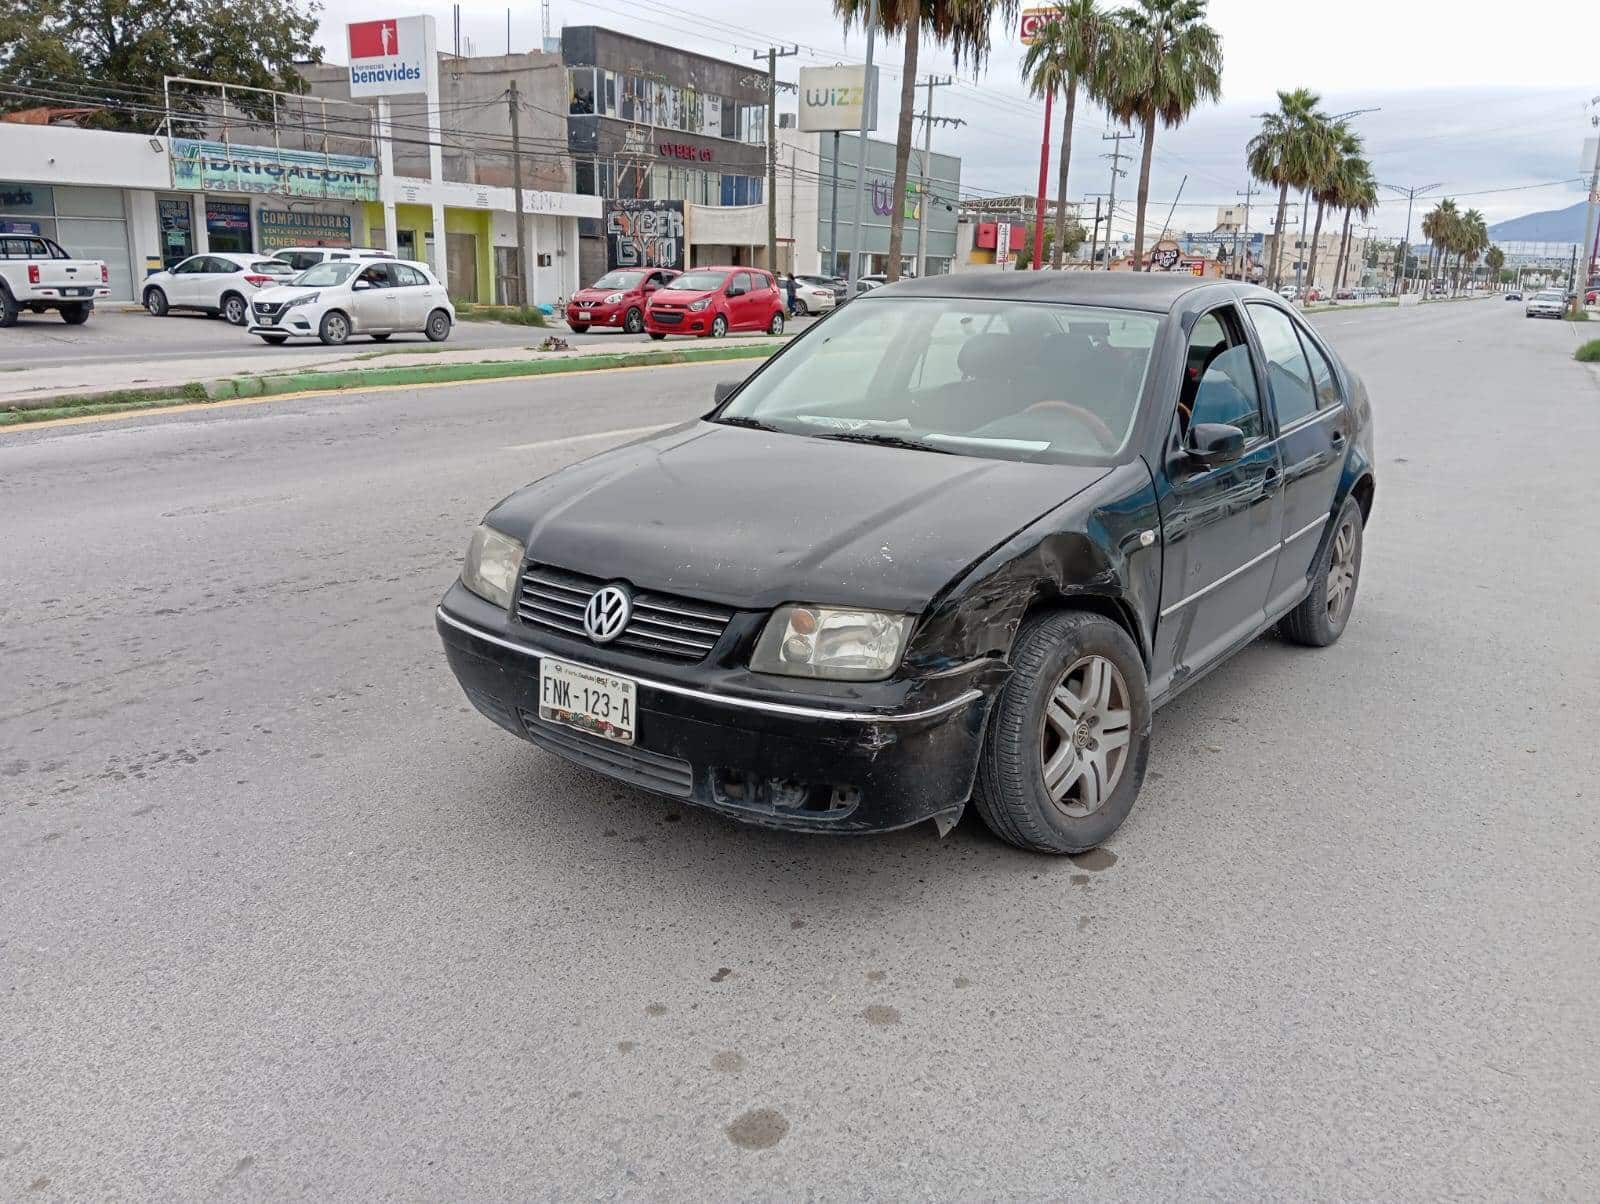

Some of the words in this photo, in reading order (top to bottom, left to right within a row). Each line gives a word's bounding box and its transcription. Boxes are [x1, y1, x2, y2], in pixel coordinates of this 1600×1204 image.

[352, 62, 421, 84] benavides
[660, 143, 696, 160] CYBER
[262, 212, 350, 228] COMPUTADORAS
[608, 208, 684, 238] CYBER
[264, 237, 297, 247] TONER
[616, 235, 677, 268] GYM
[544, 676, 630, 726] FNK-123-A
